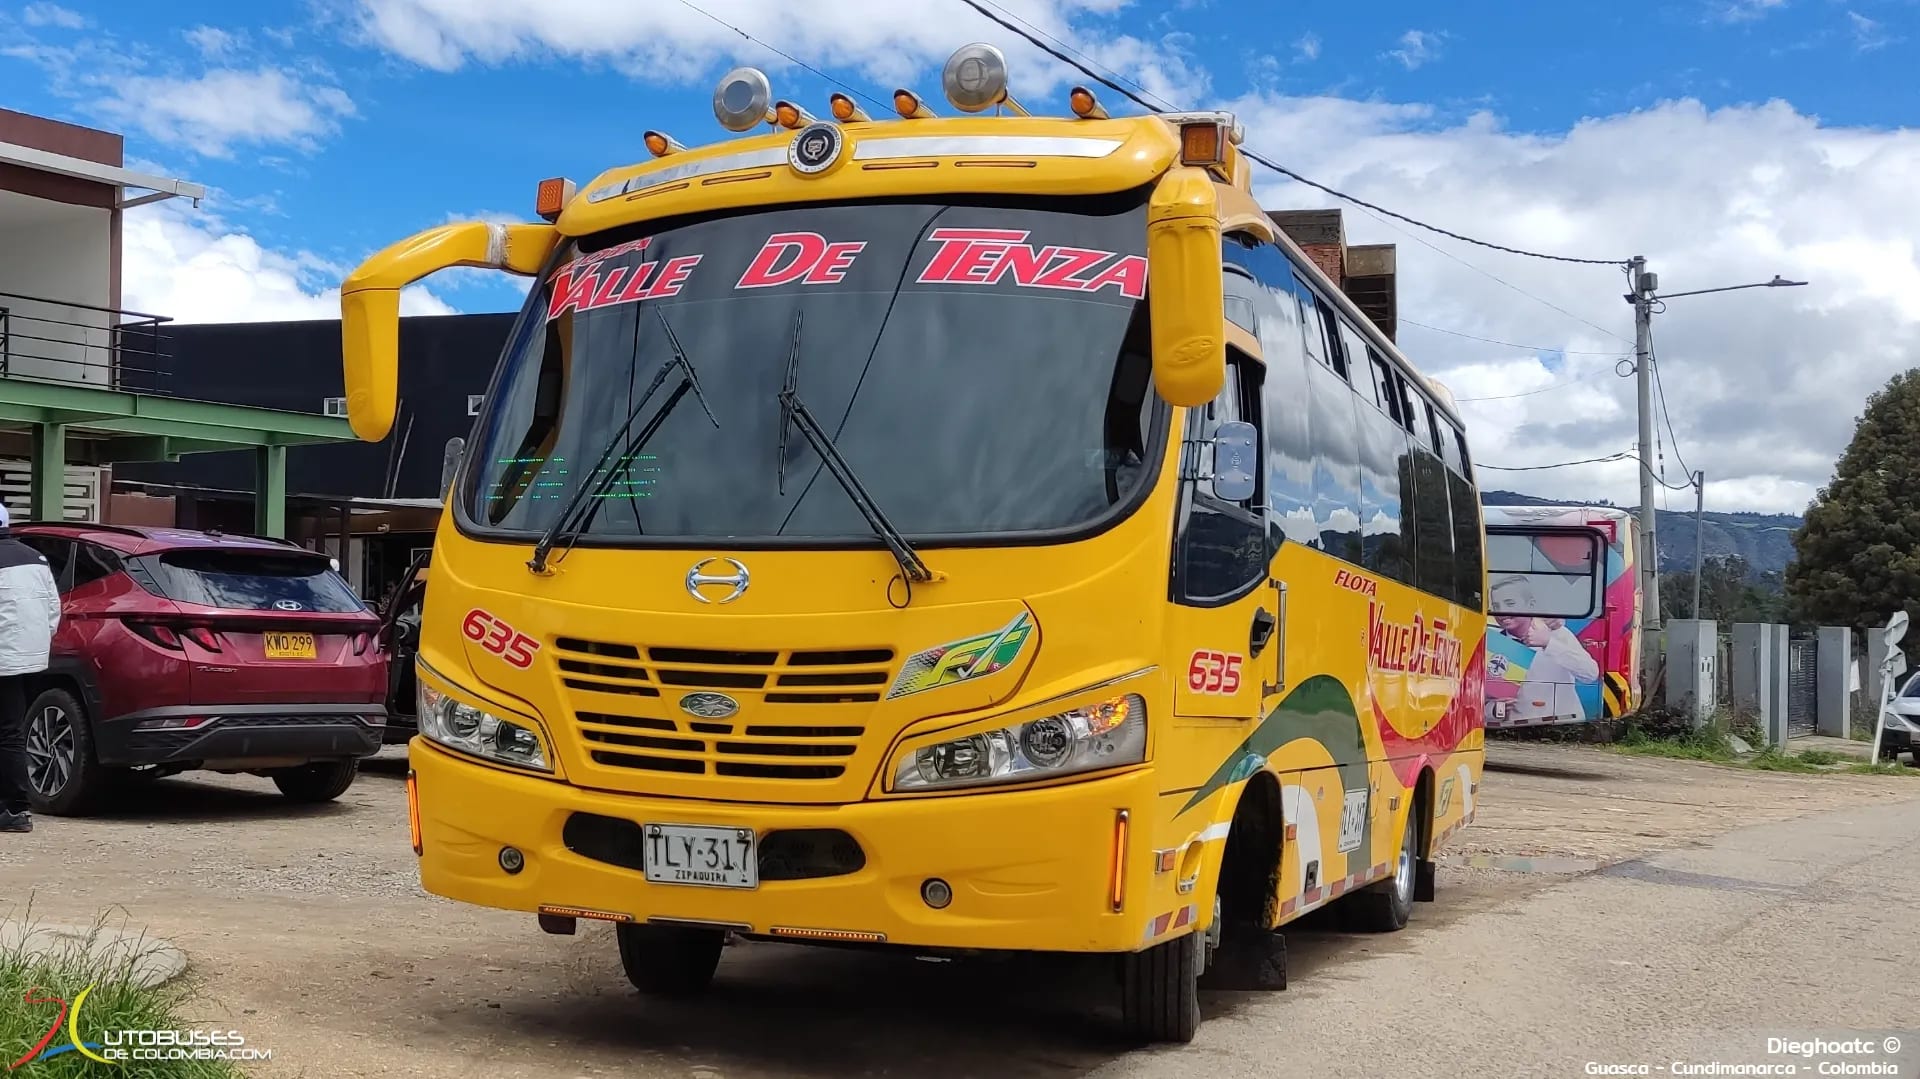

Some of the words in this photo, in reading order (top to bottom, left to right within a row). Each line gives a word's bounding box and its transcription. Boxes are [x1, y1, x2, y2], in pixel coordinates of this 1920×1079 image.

[546, 254, 704, 323] VALLE
[735, 232, 868, 289] DE
[916, 228, 1148, 300] TENZA
[1335, 568, 1378, 597] FLOTA
[292, 636, 313, 651] 299
[462, 608, 541, 670] 635
[1367, 600, 1409, 672] VALLE
[1430, 618, 1461, 680] TENZA
[1188, 649, 1243, 695] 635
[674, 869, 728, 884] ZIPAQUIRA
